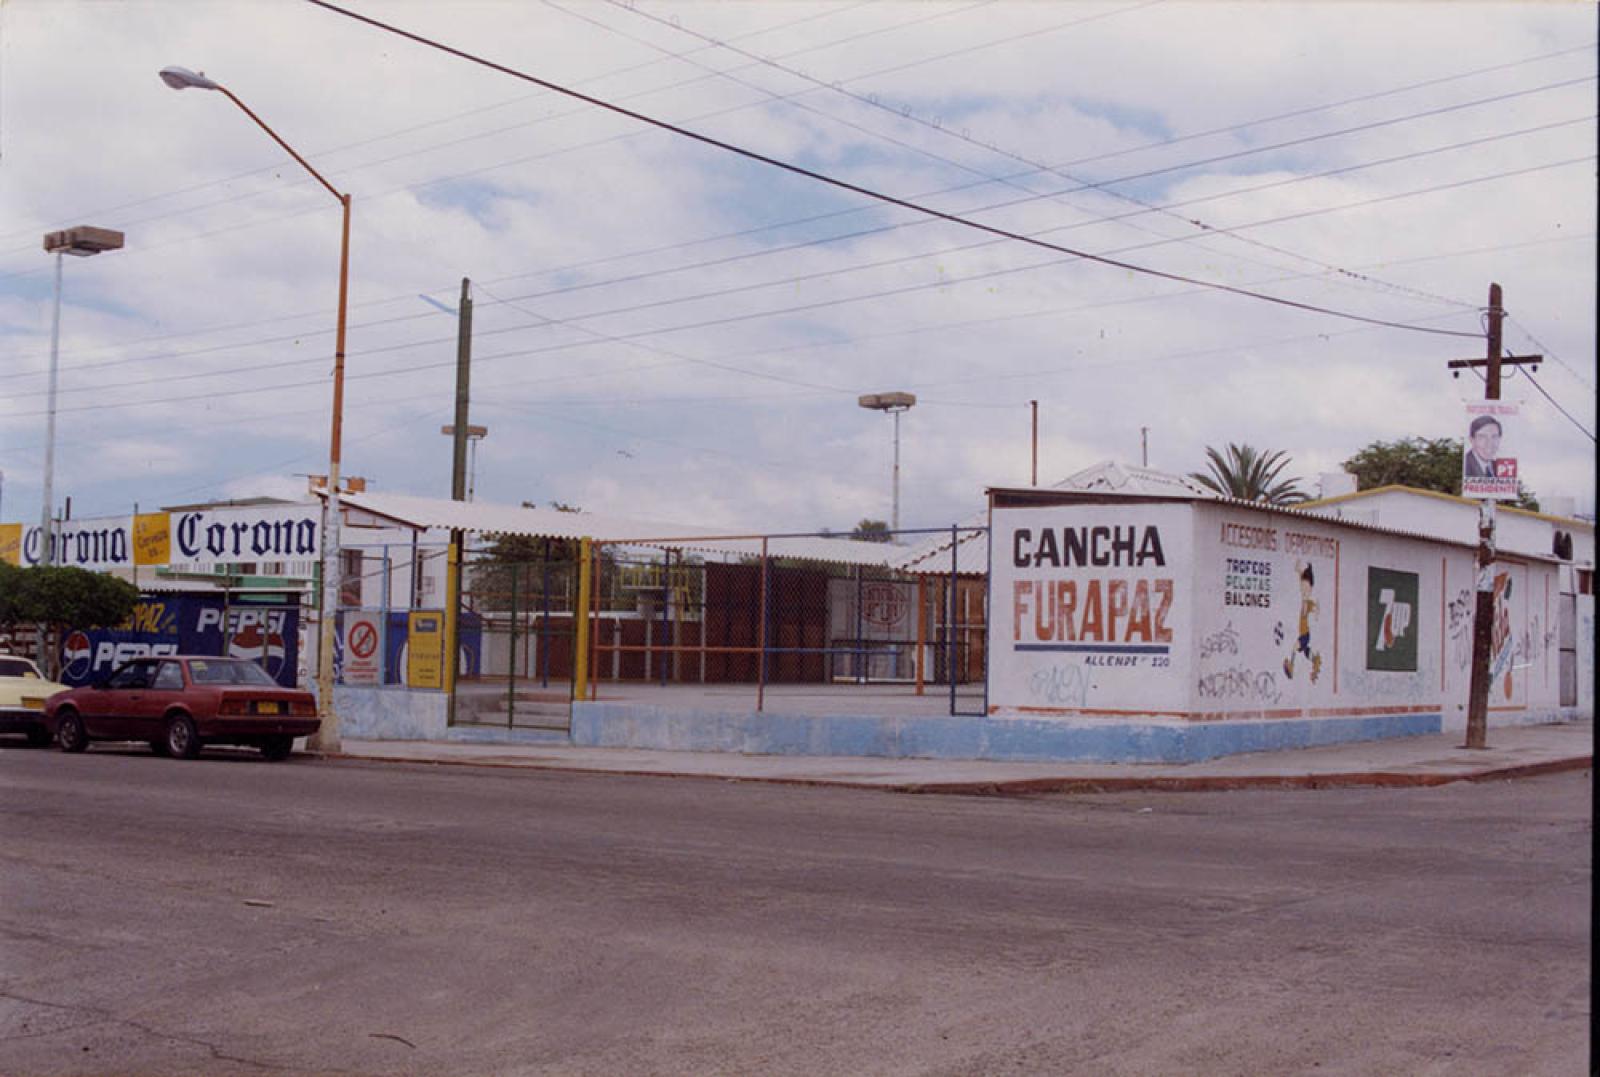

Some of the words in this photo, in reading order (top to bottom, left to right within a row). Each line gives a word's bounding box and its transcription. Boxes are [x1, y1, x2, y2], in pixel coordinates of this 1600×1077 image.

[1497, 463, 1515, 476] PT
[177, 512, 316, 558] Corona
[1013, 525, 1166, 568] CANCHA
[1221, 522, 1277, 552] ACCESORIOS
[1226, 558, 1272, 576] TROFEOS
[1225, 575, 1272, 591] PELOTAS
[1013, 579, 1174, 642] FURAPAZ
[1224, 591, 1271, 608] BALONES
[196, 607, 287, 635] PEPSI
[1085, 655, 1138, 667] ALLENDE
